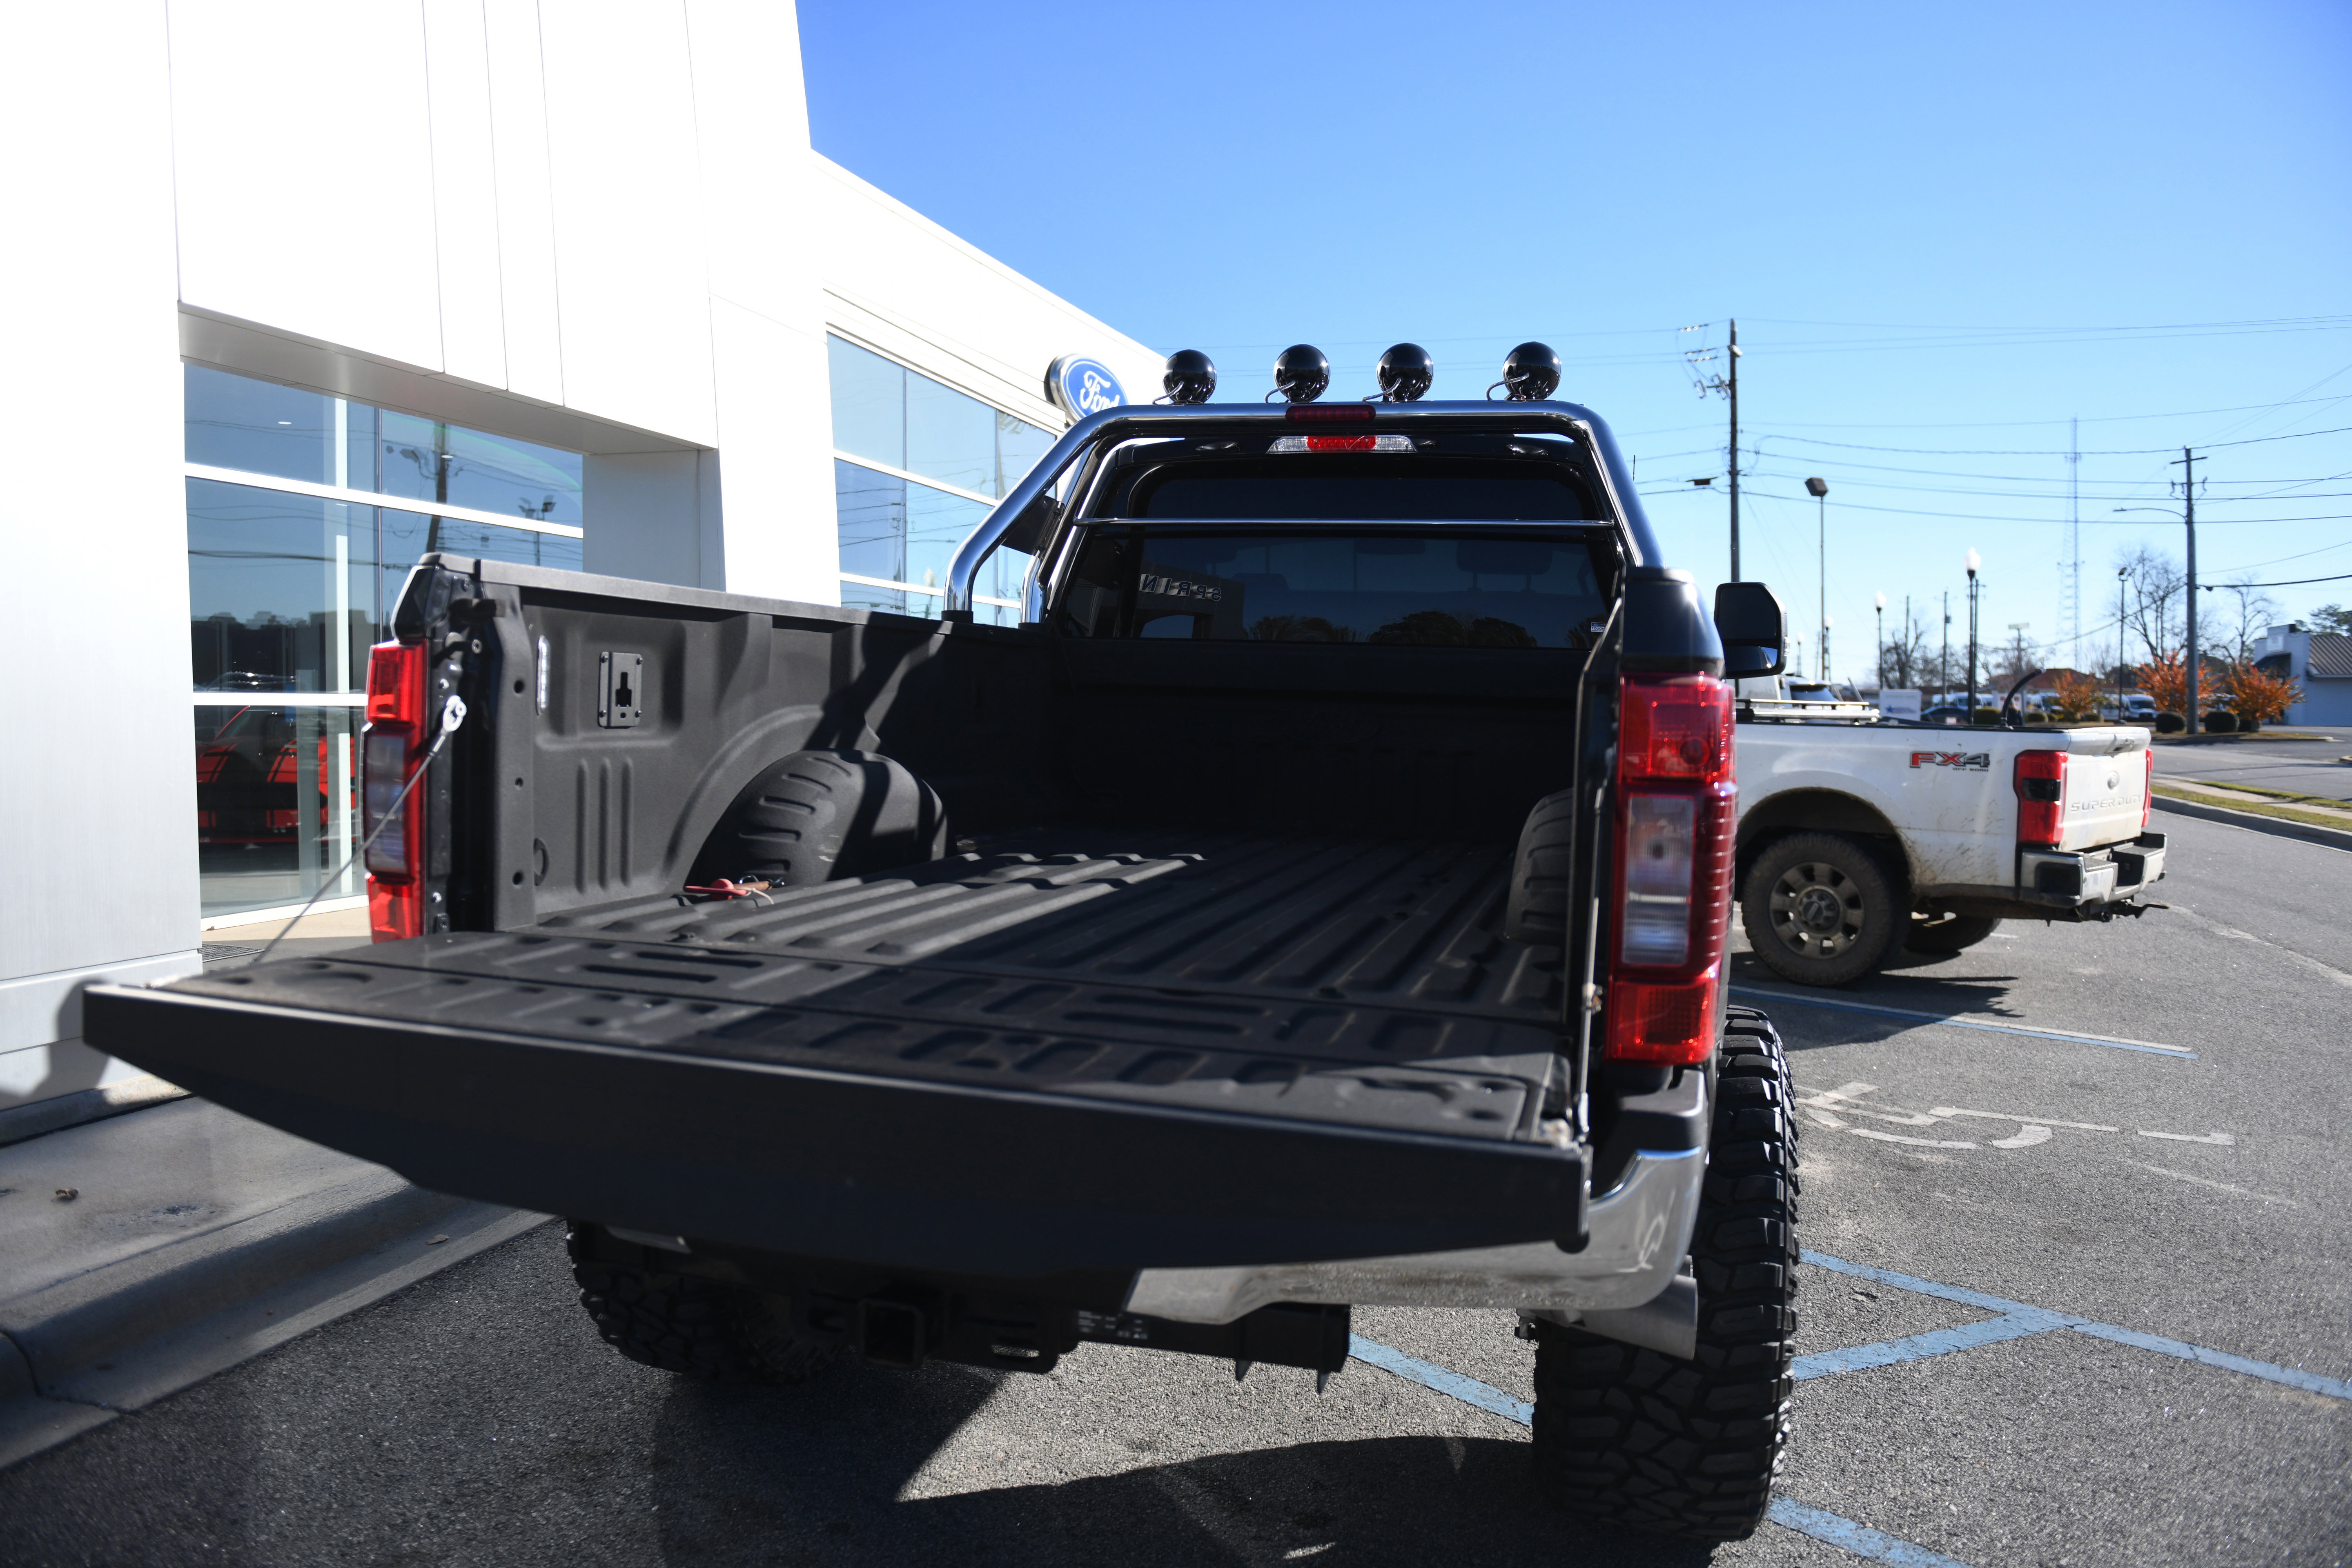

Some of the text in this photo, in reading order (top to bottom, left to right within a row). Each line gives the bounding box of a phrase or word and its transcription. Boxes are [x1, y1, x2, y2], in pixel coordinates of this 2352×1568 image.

[1080, 371, 1120, 413] Ford
[1910, 751, 1990, 768] FX4
[2070, 794, 2142, 813] SUPER DUTY
